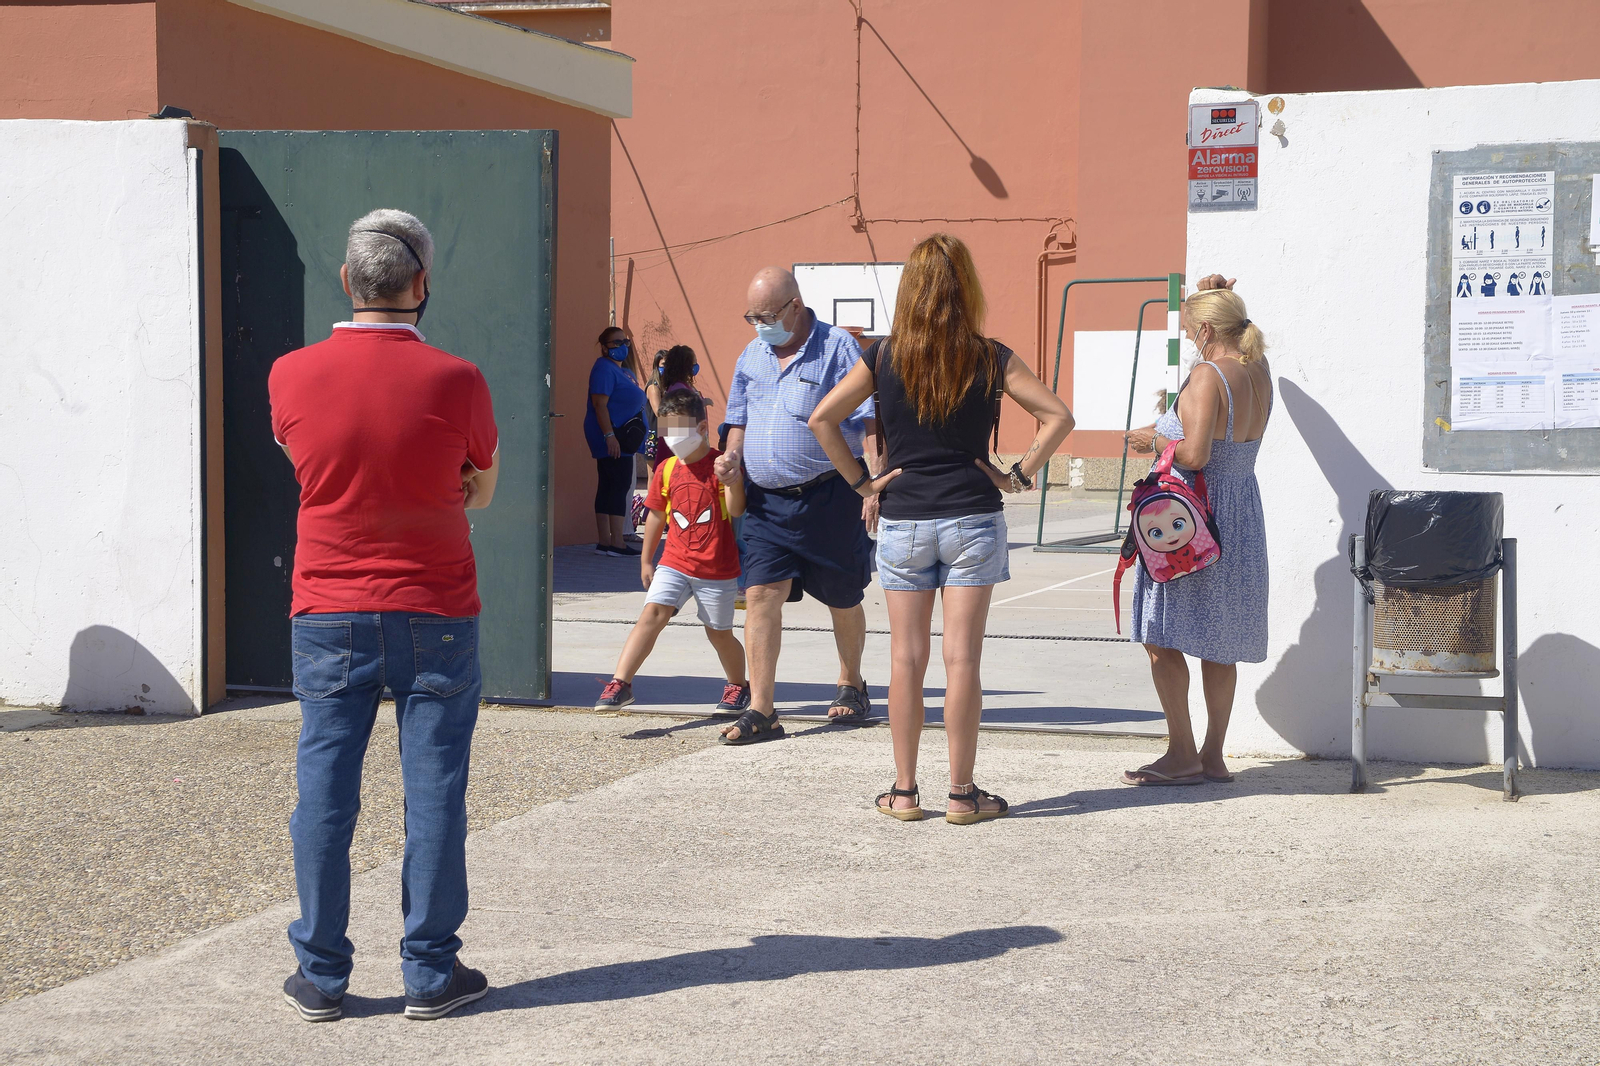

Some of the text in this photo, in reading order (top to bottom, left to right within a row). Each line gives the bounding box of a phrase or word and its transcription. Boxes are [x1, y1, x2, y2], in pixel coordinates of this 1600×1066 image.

[1200, 122, 1249, 144] Direct
[1191, 150, 1255, 166] Alarma
[1197, 165, 1249, 174] zerovision
